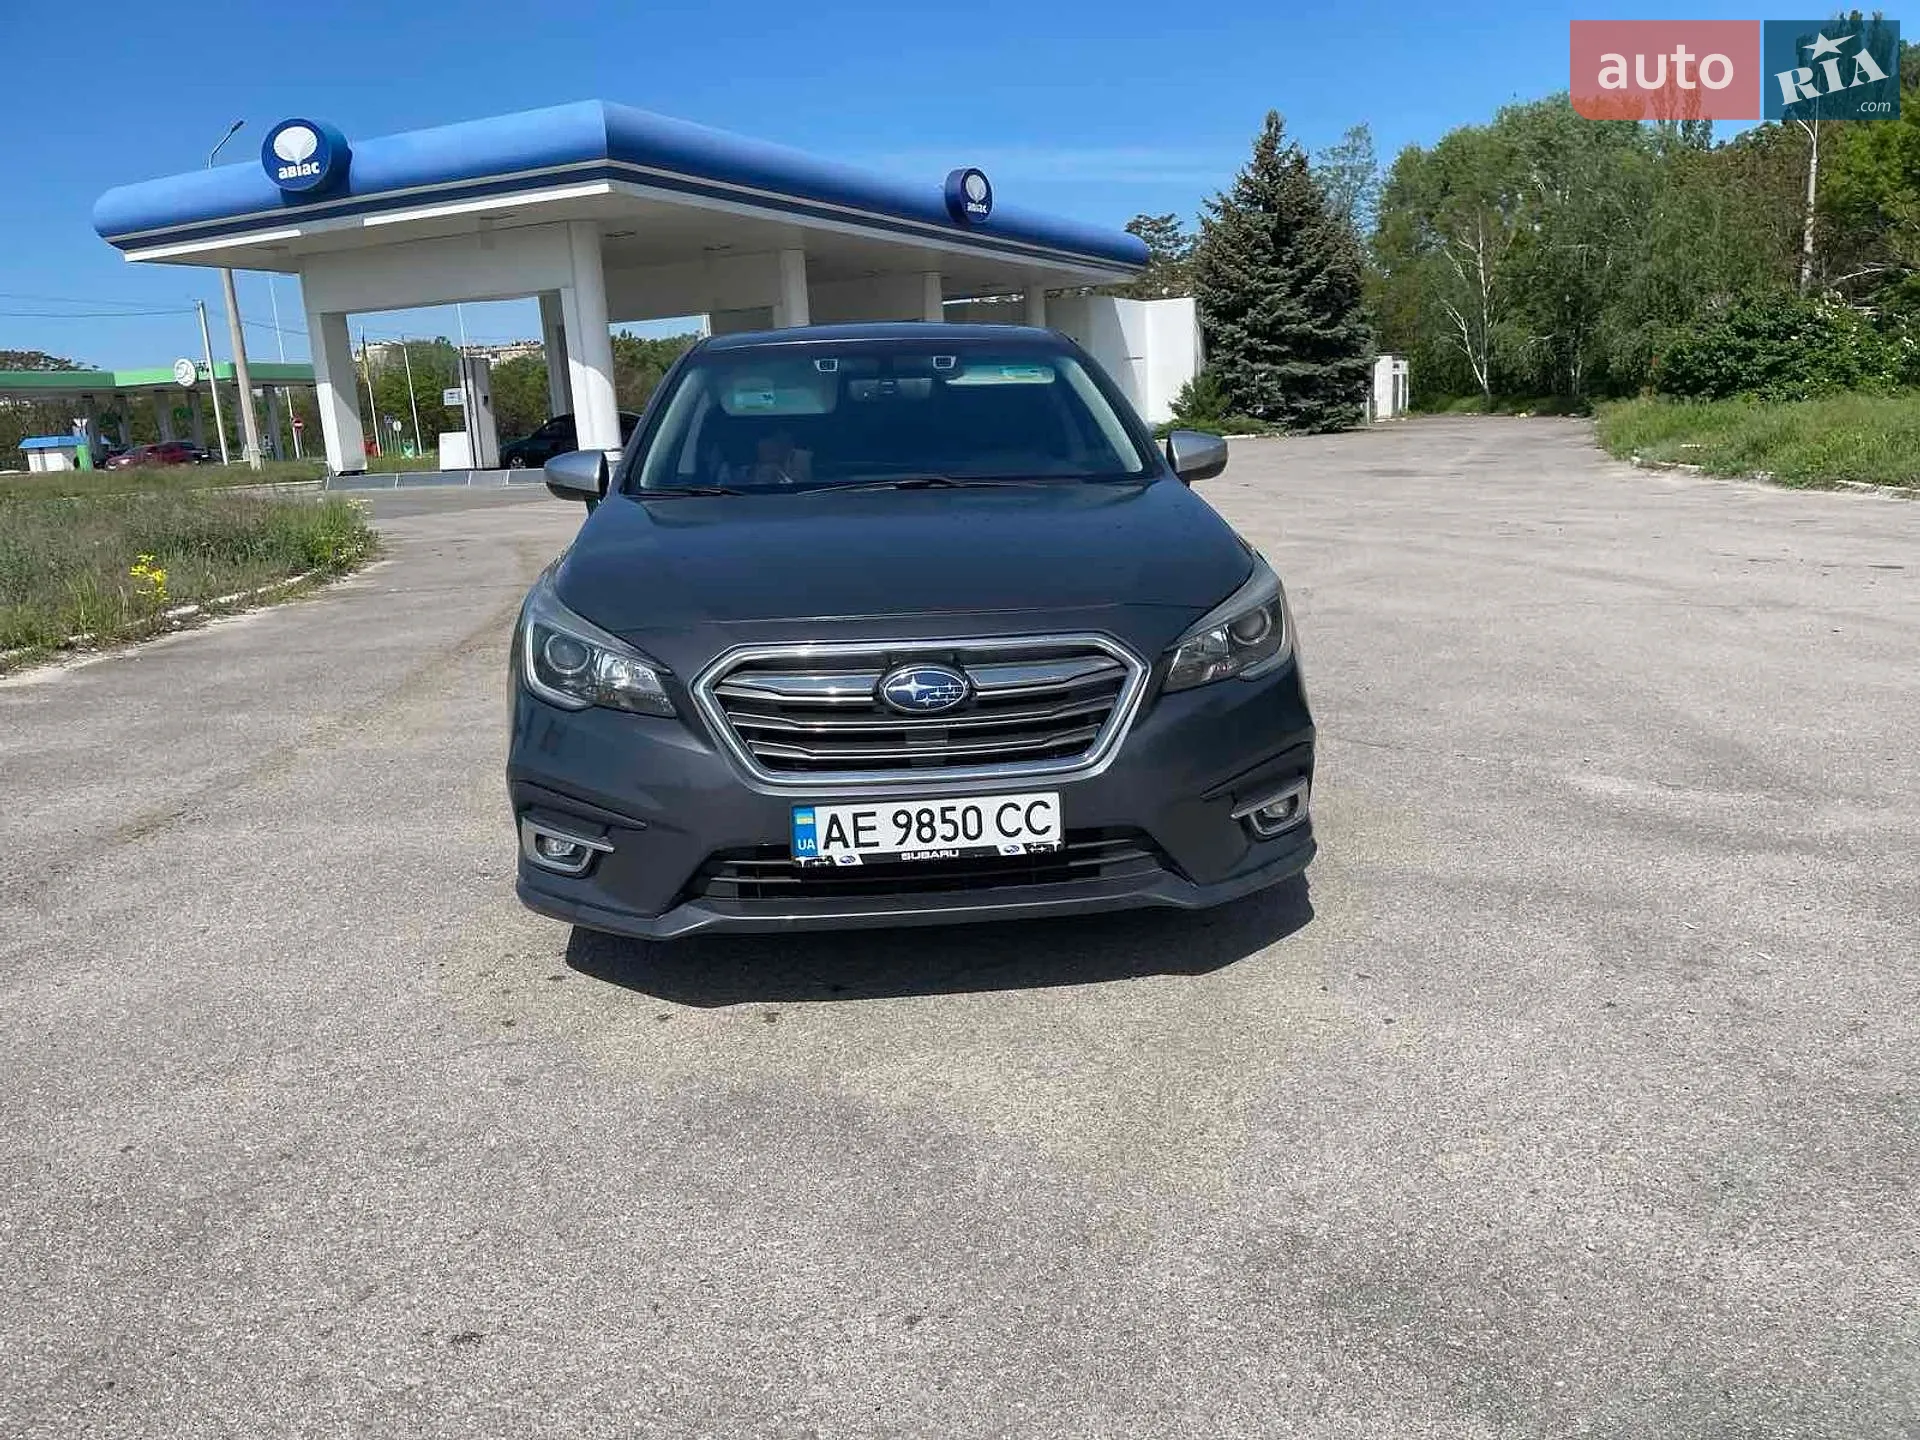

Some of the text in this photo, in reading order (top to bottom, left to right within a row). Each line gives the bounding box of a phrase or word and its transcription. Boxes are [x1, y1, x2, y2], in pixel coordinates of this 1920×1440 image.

[823, 800, 1051, 850] AE 9850 CC
[797, 838, 816, 850] UA
[901, 849, 959, 861] SUBARU
